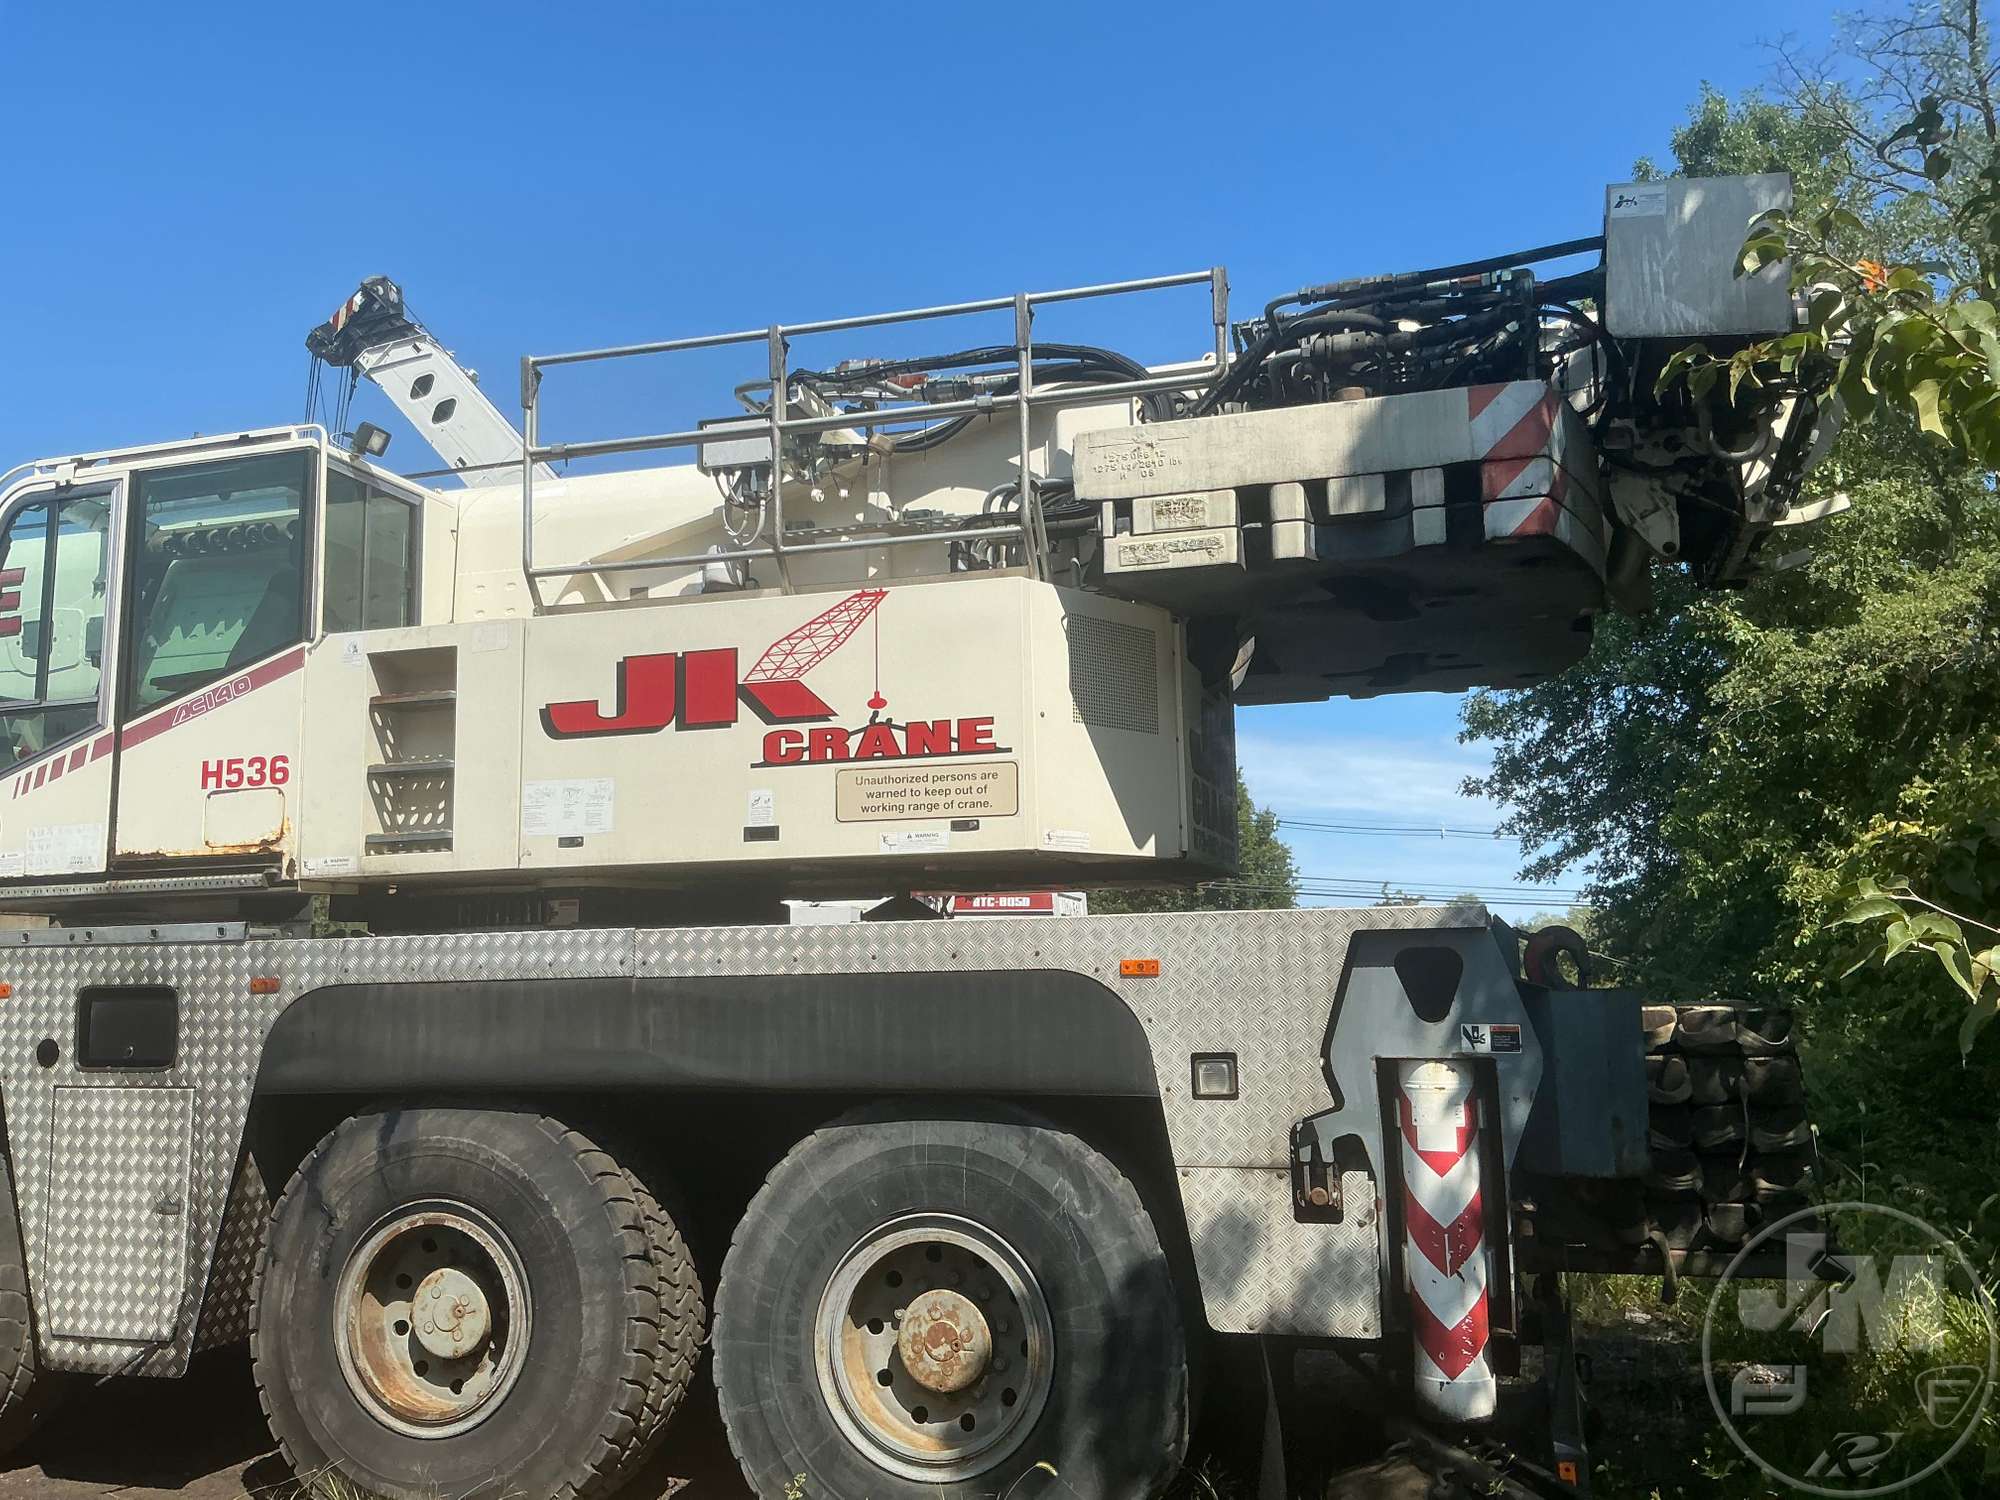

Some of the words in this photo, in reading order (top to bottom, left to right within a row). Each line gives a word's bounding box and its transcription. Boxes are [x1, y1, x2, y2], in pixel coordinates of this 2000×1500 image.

[172, 676, 252, 727] AC140
[539, 647, 839, 740] JK
[761, 716, 1000, 766] CRANE
[201, 755, 290, 790] H536
[855, 773, 929, 786] Unauthorized
[932, 773, 978, 784] persons
[980, 771, 999, 780] are
[860, 802, 905, 814] working
[908, 802, 940, 812] range
[943, 800, 956, 810] of
[957, 800, 993, 810] crane.
[865, 787, 907, 799] warned
[910, 787, 921, 797] to
[924, 786, 952, 798] keep
[955, 786, 973, 795] out
[976, 785, 988, 795] of
